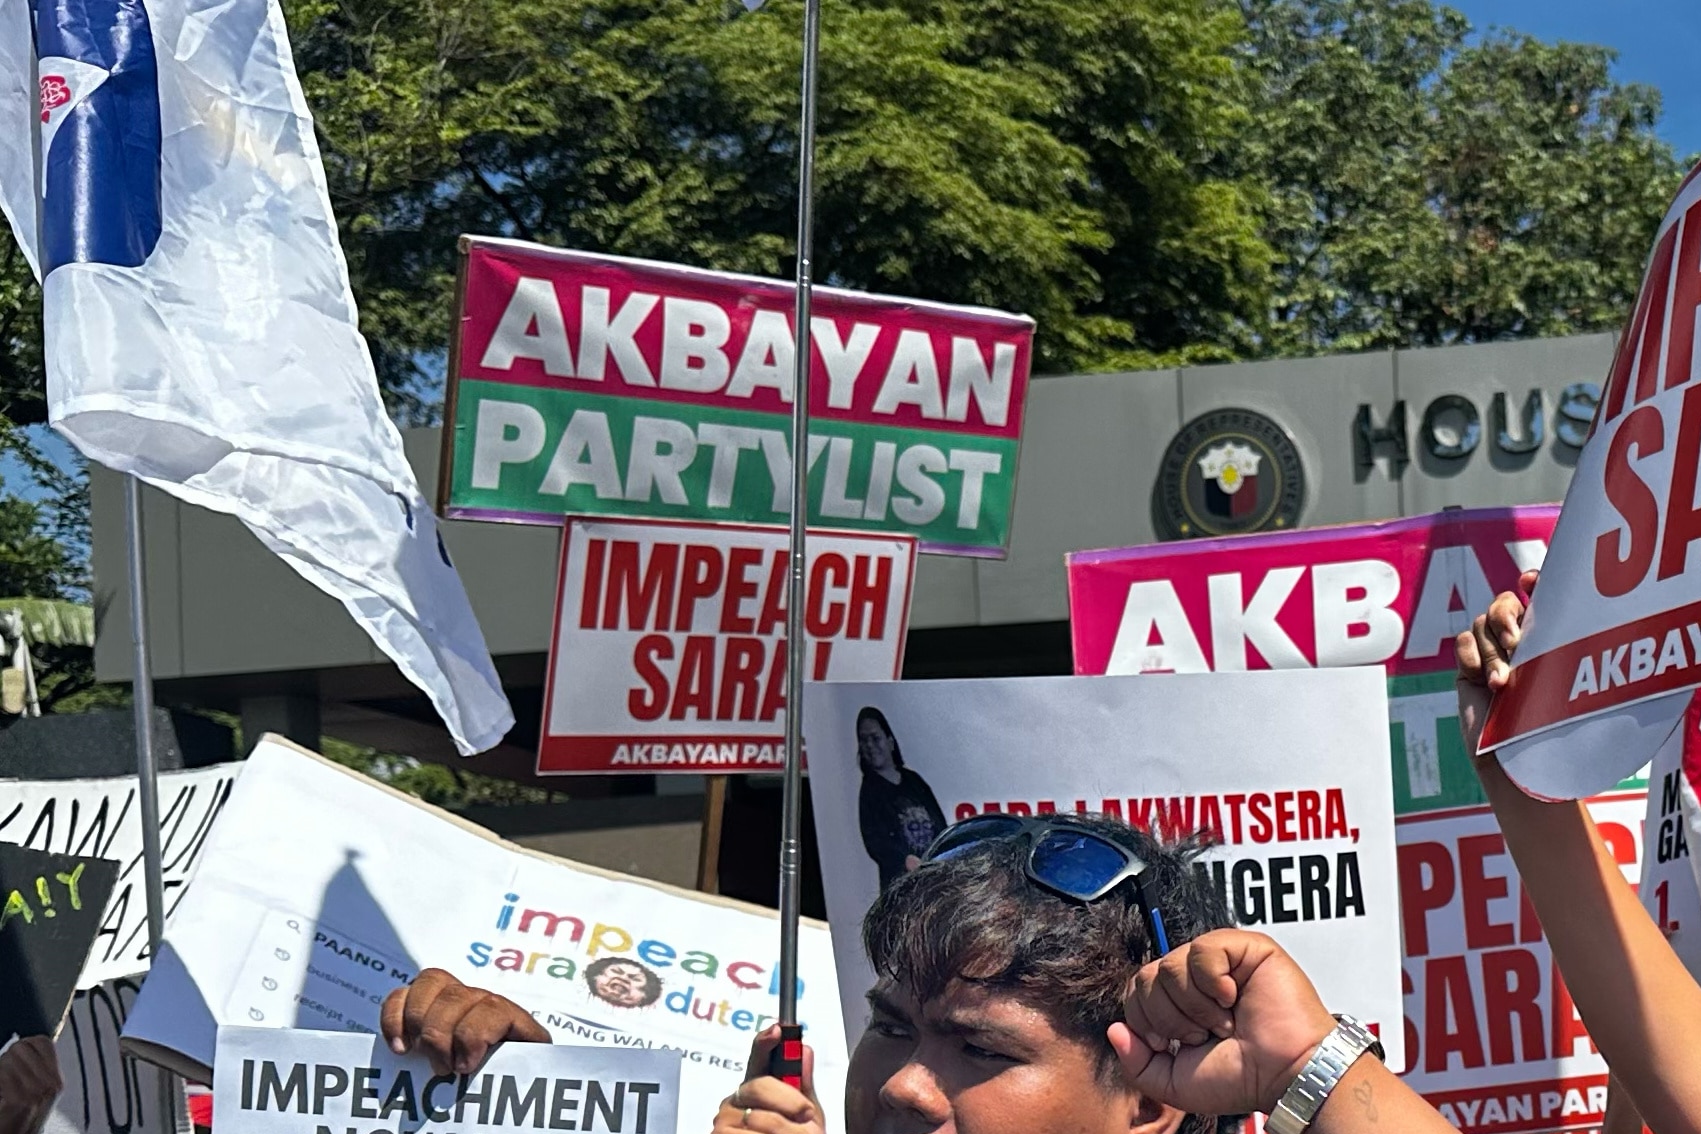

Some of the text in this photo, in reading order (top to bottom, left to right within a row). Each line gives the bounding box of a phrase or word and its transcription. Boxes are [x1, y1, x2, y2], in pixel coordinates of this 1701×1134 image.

[480, 276, 1017, 428] AKBAYAN
[471, 398, 1002, 530] PARTYLIST
[579, 538, 894, 641] IMPEACH
[627, 633, 834, 722] SARA!
[611, 743, 739, 765] AKBAYAN
[313, 932, 417, 985] PAANO M
[466, 940, 577, 981] sara
[293, 993, 343, 1022] receipt
[664, 988, 808, 1033] duter
[546, 1011, 605, 1042] NANG
[613, 1033, 703, 1063] WANG
